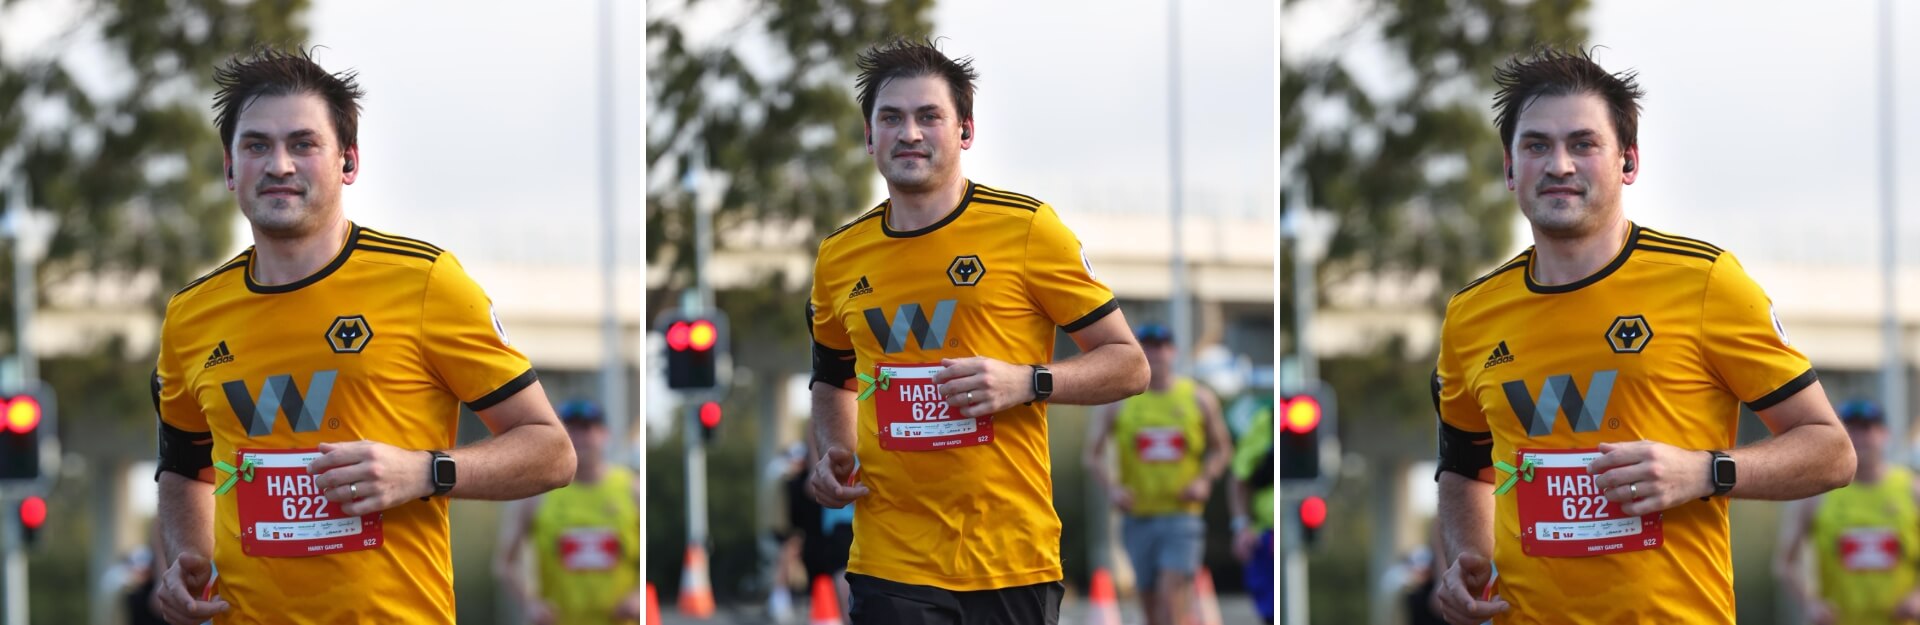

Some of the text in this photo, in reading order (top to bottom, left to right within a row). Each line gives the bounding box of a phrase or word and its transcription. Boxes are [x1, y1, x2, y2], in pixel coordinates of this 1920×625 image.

[848, 287, 874, 299] adidas
[204, 354, 235, 369] adidas
[1484, 354, 1515, 369] adidas
[912, 401, 950, 421] 622
[282, 495, 329, 520] 622
[1562, 495, 1609, 520] 622
[363, 538, 377, 547] 622
[1643, 538, 1657, 547] 622
